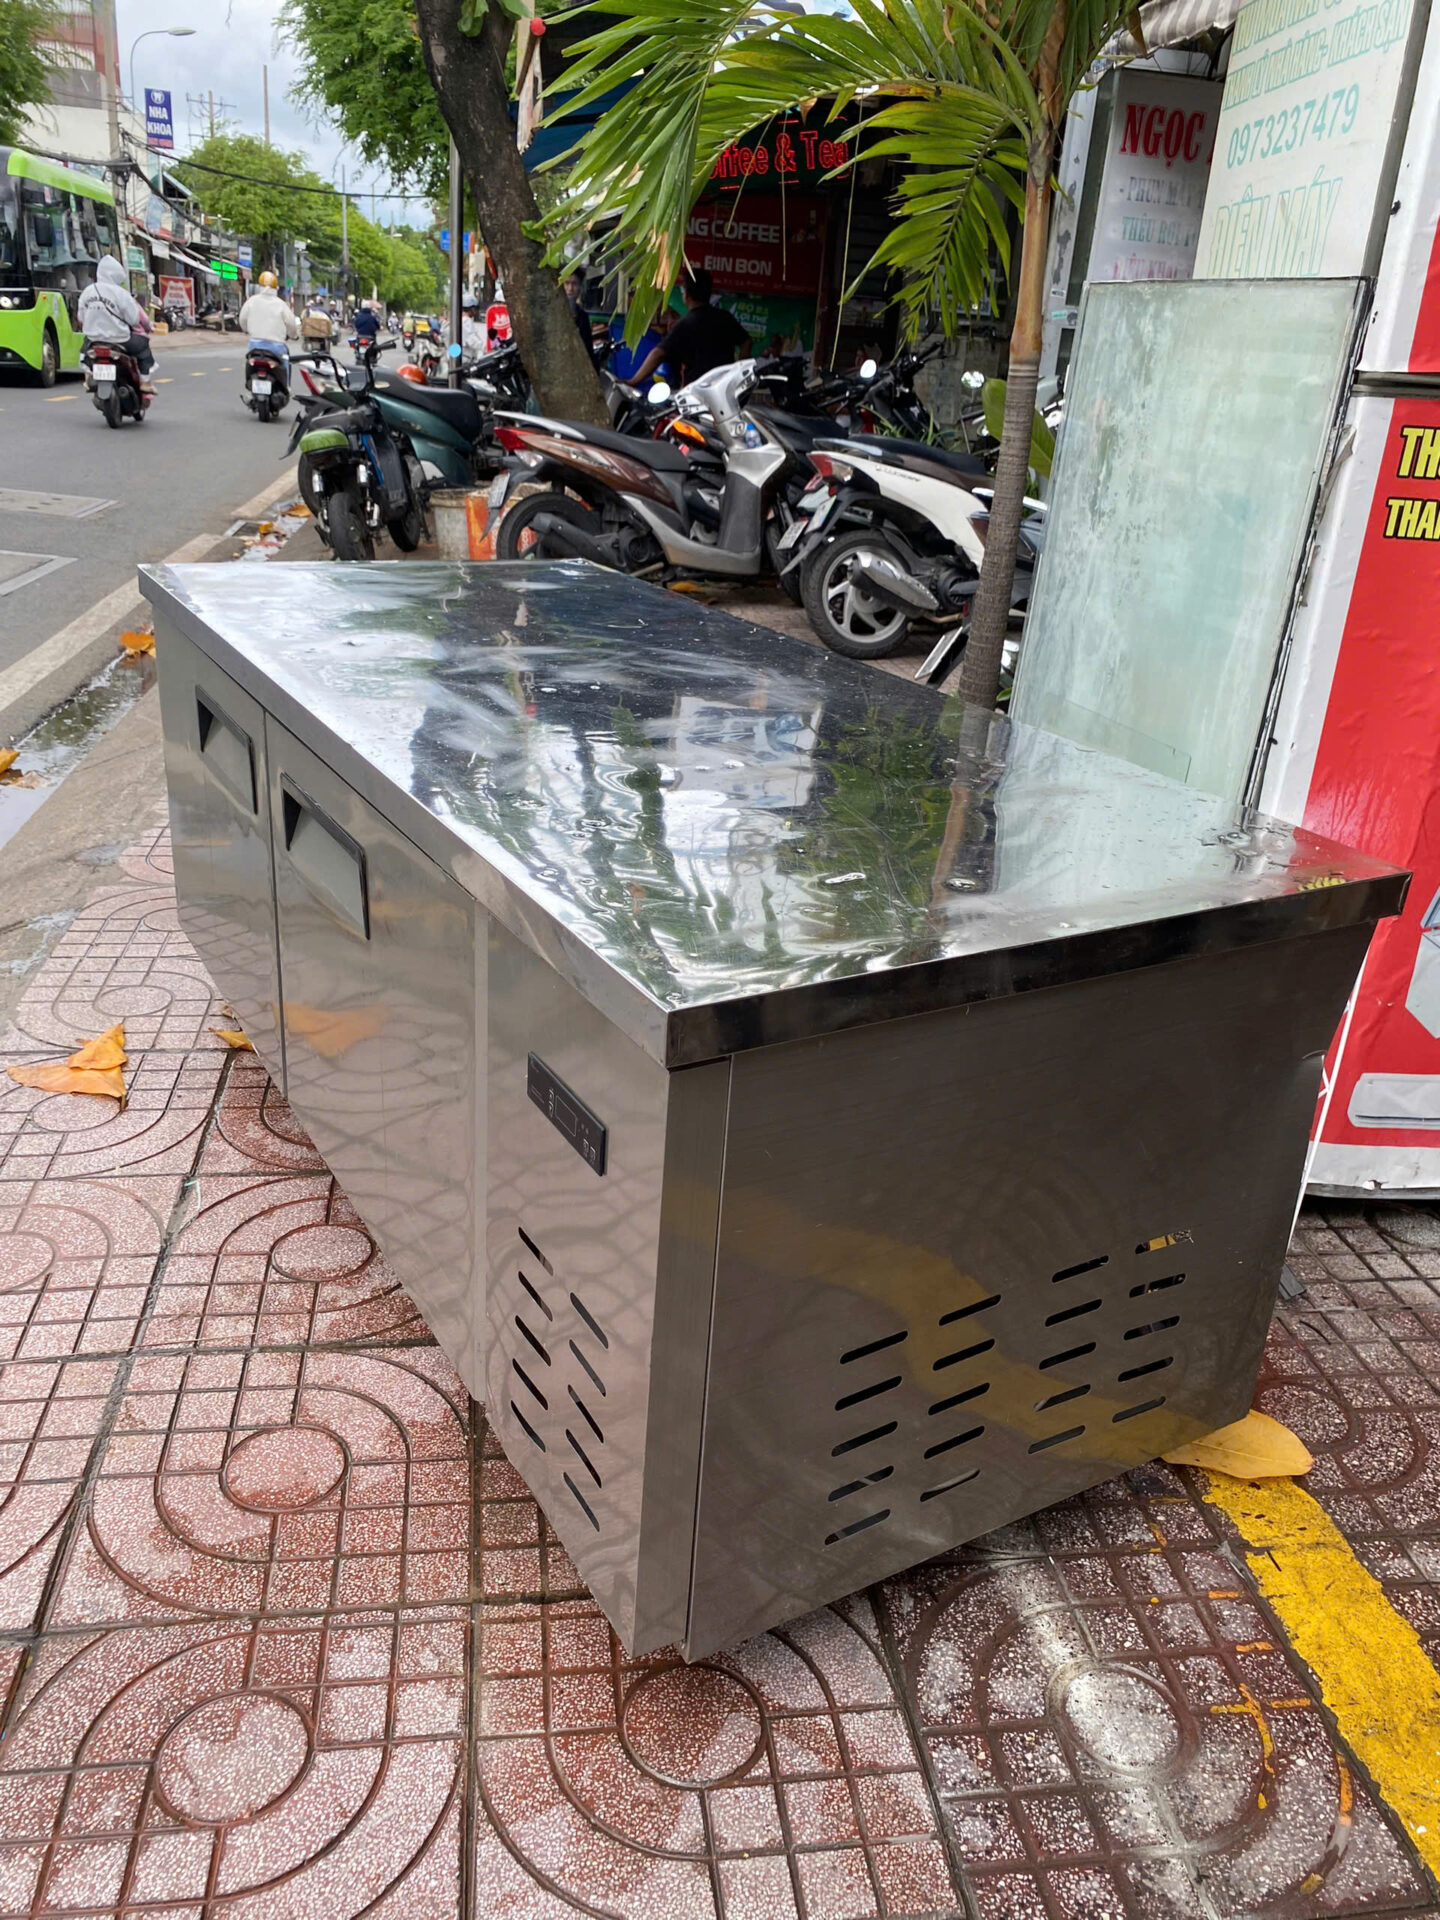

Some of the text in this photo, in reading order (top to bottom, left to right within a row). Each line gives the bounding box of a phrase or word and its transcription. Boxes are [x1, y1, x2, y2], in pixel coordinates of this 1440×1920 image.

[148, 105, 169, 120] NHA
[1227, 83, 1360, 169] 0973237479
[147, 121, 173, 136] KHOA
[1119, 102, 1206, 168] NGỌC
[686, 216, 709, 236] NG
[711, 219, 780, 243] COFFEE
[735, 258, 772, 276] BON
[1397, 425, 1440, 479] TH
